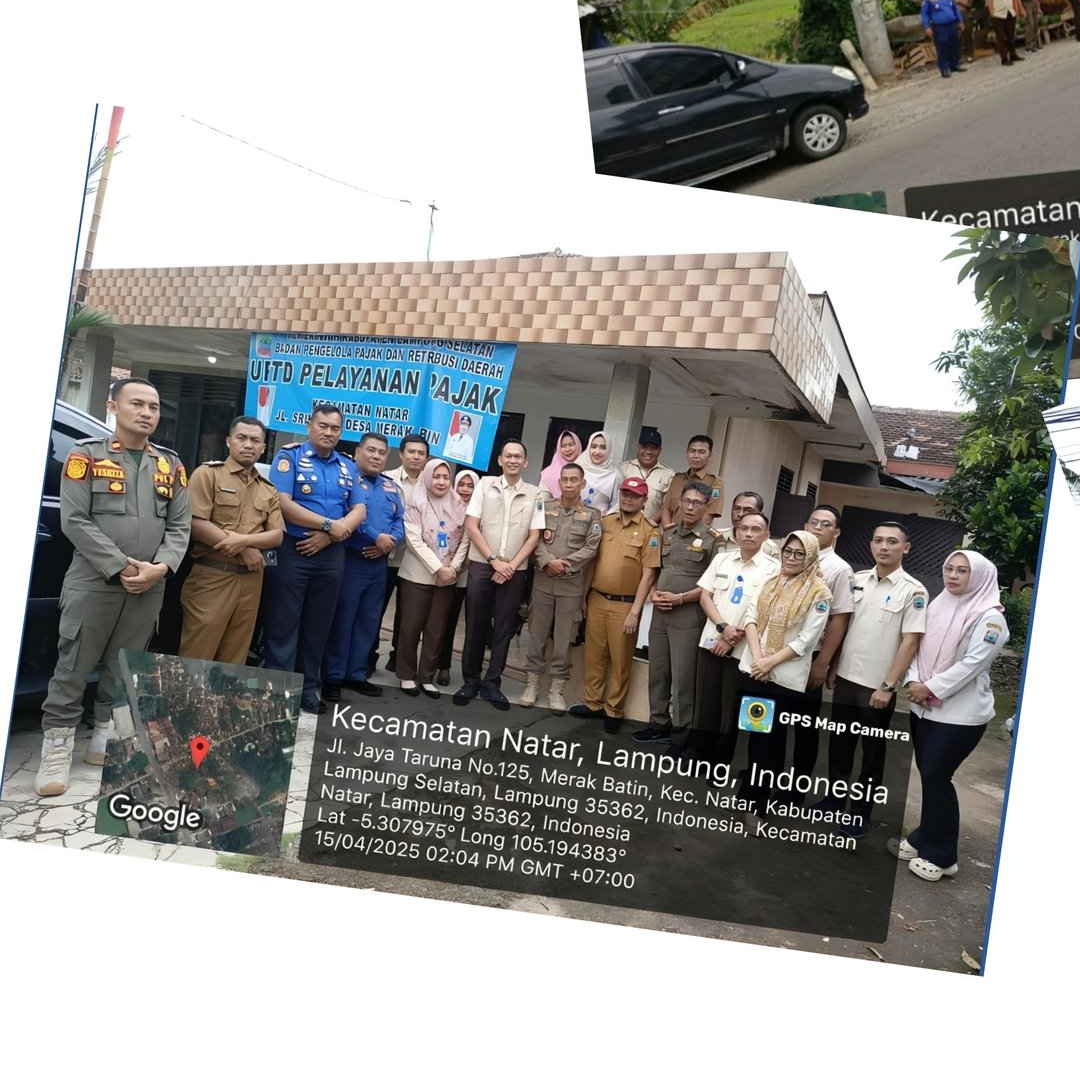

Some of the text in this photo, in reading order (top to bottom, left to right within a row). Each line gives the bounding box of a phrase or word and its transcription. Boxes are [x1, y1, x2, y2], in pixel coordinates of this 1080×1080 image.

[274, 342, 504, 379] BADAN PENGELOLA PAJAK DAN DAERAH
[446, 340, 495, 358] SELATAN
[299, 361, 421, 396] PELAYANAN
[275, 410, 288, 421] JL.
[345, 418, 371, 433] DESA
[375, 405, 409, 421] NATAR
